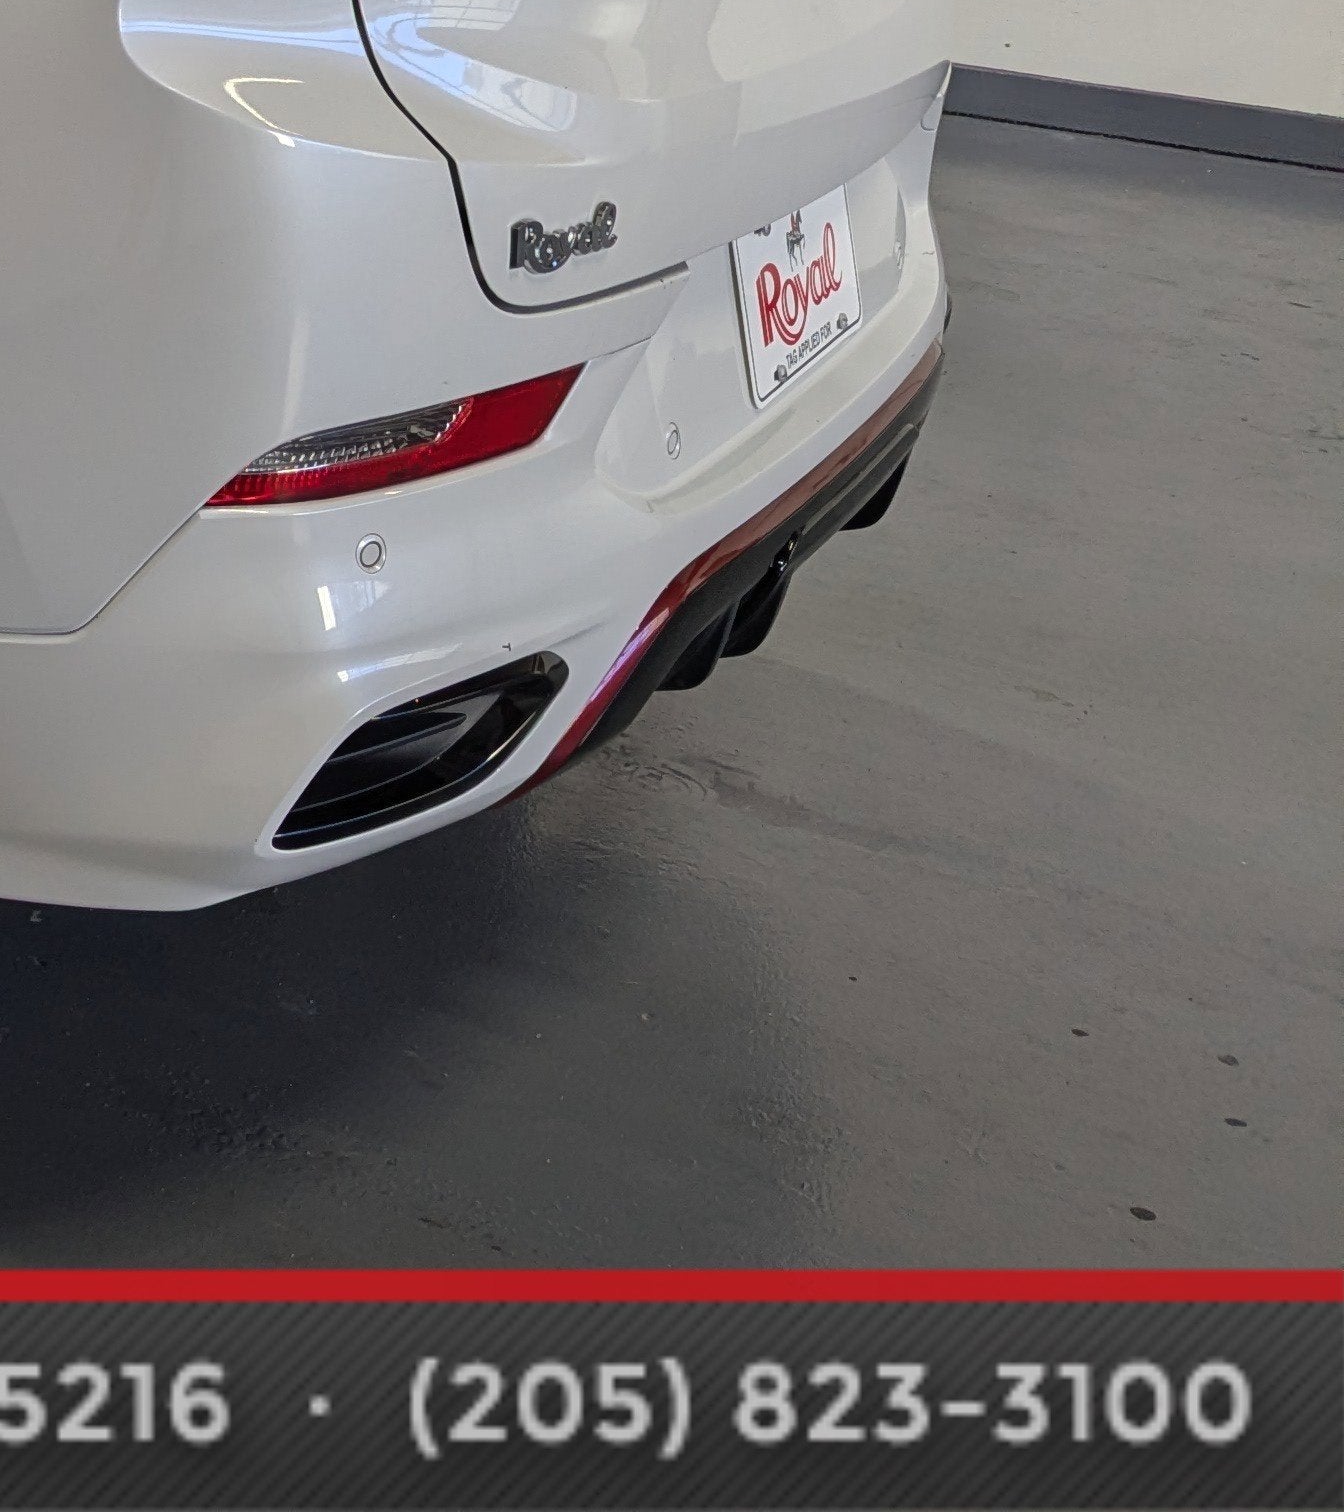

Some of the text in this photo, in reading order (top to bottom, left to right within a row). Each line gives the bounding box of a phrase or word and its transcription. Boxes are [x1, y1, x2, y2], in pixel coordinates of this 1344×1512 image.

[509, 200, 618, 274] Royal
[755, 222, 843, 348] Royal
[785, 321, 832, 368] TAG APPLIED FOR
